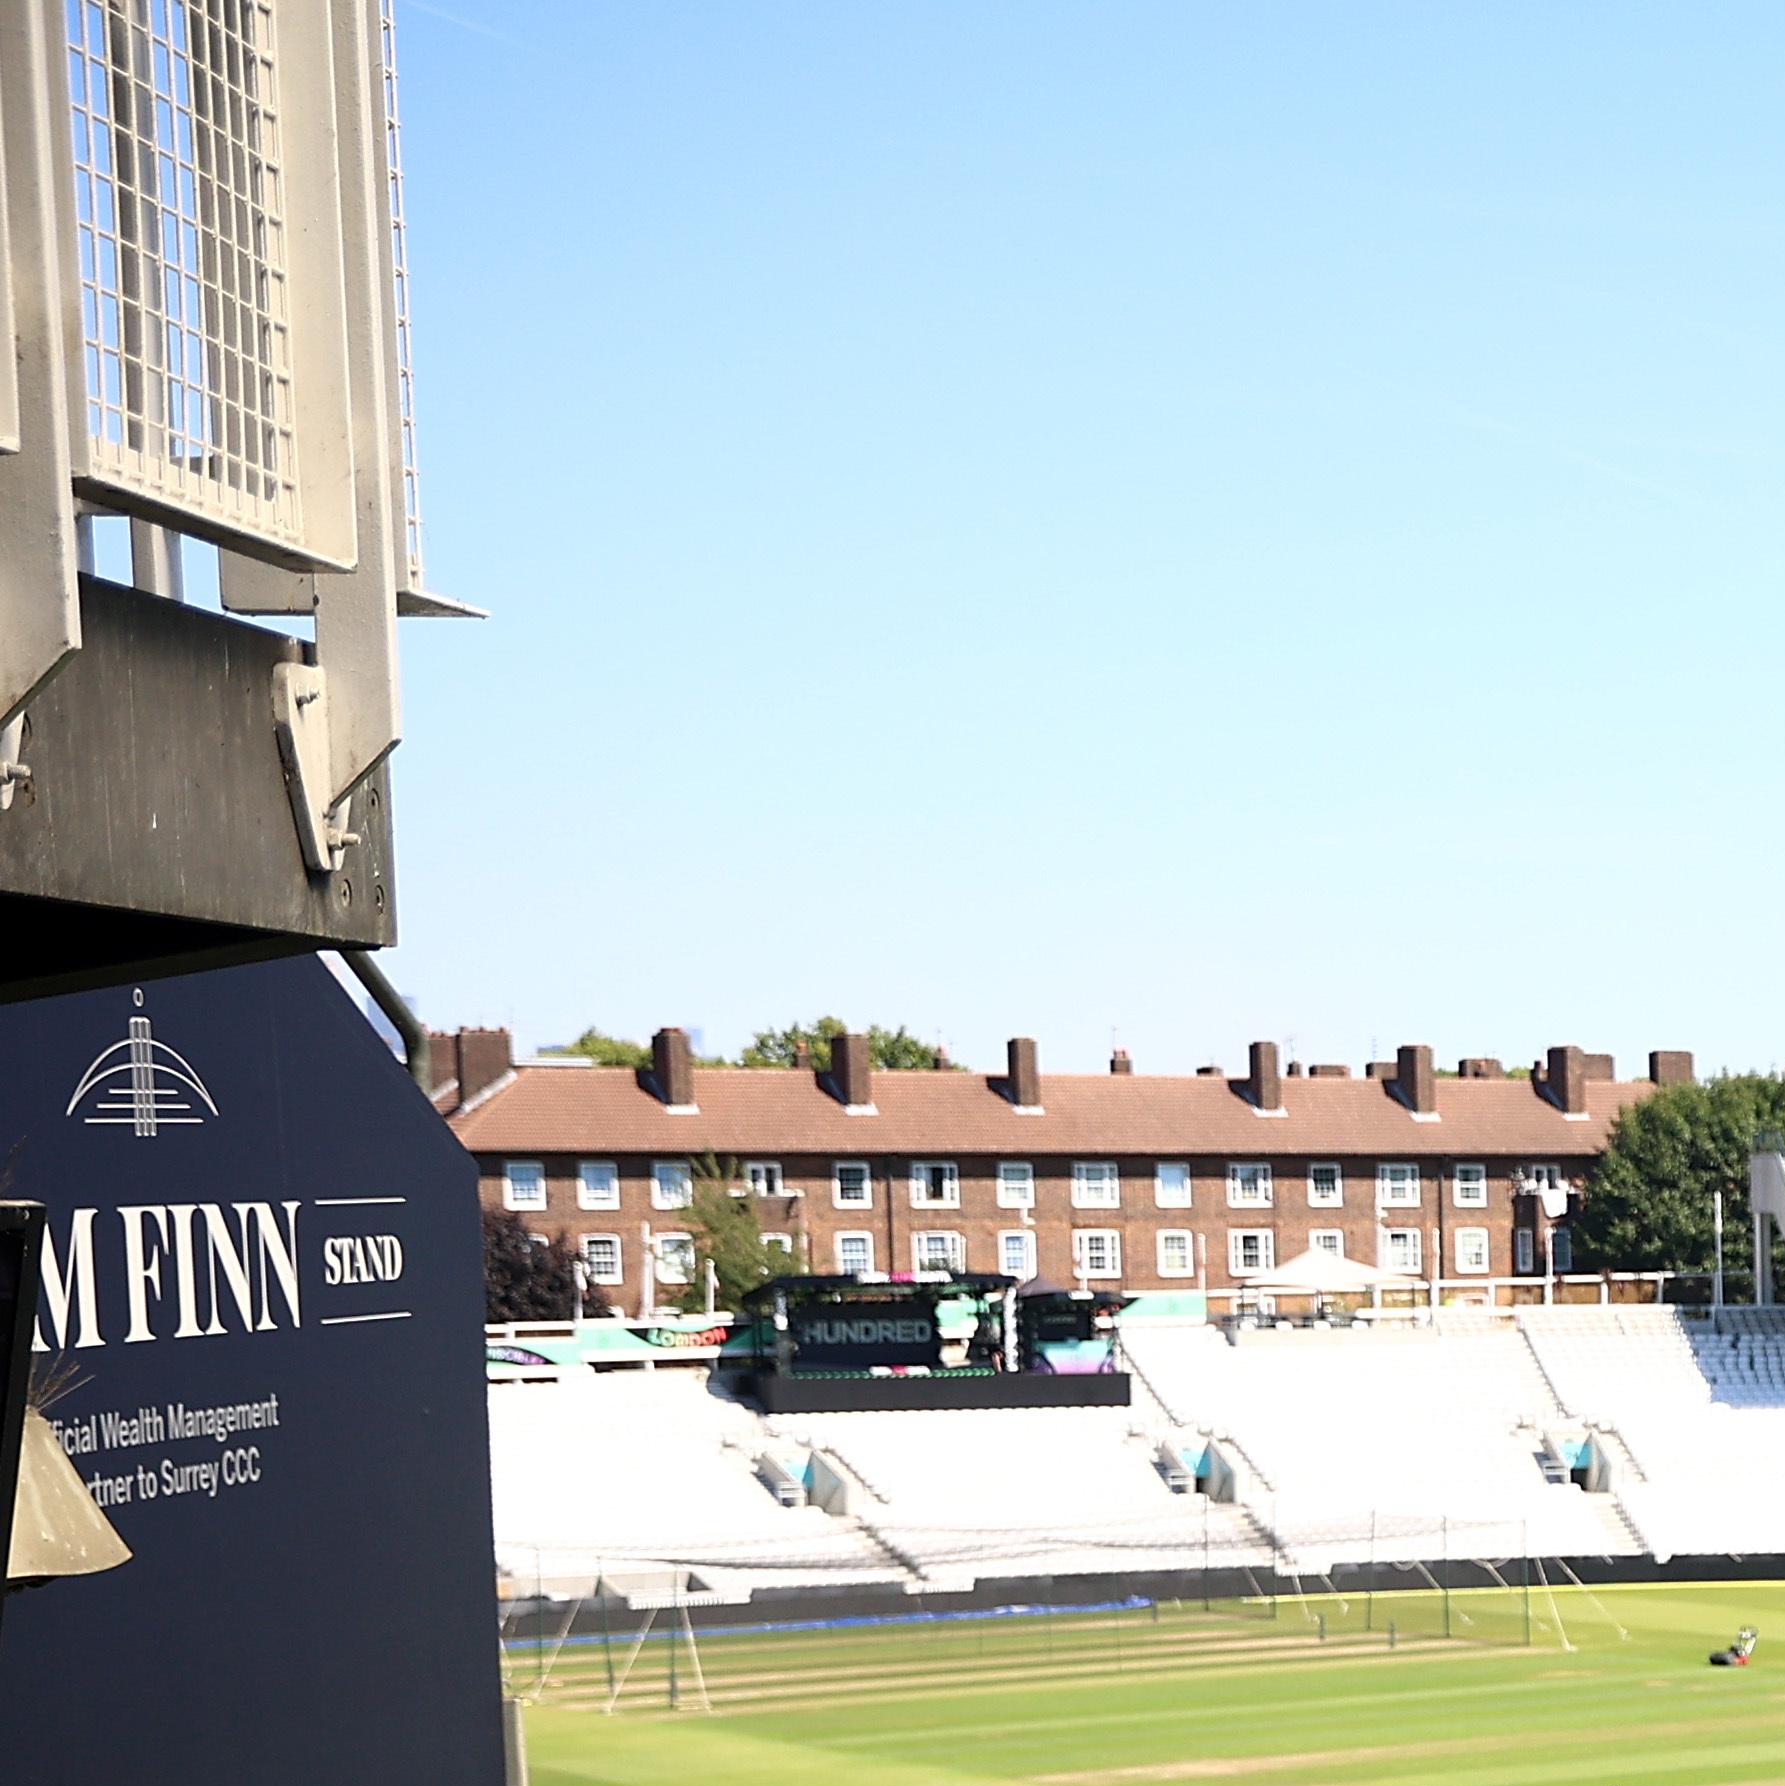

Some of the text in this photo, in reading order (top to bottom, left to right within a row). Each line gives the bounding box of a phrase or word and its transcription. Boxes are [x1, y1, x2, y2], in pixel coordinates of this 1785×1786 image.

[116, 1201, 301, 1343] FINN
[324, 1234, 403, 1286] STAND
[649, 1326, 729, 1348] LONDON
[804, 1319, 932, 1345] HUNDRED
[100, 1406, 165, 1450] Wealth
[167, 1393, 280, 1443] Management
[137, 1465, 158, 1500] to
[160, 1459, 219, 1497] Surrey
[222, 1447, 261, 1486] CCC
